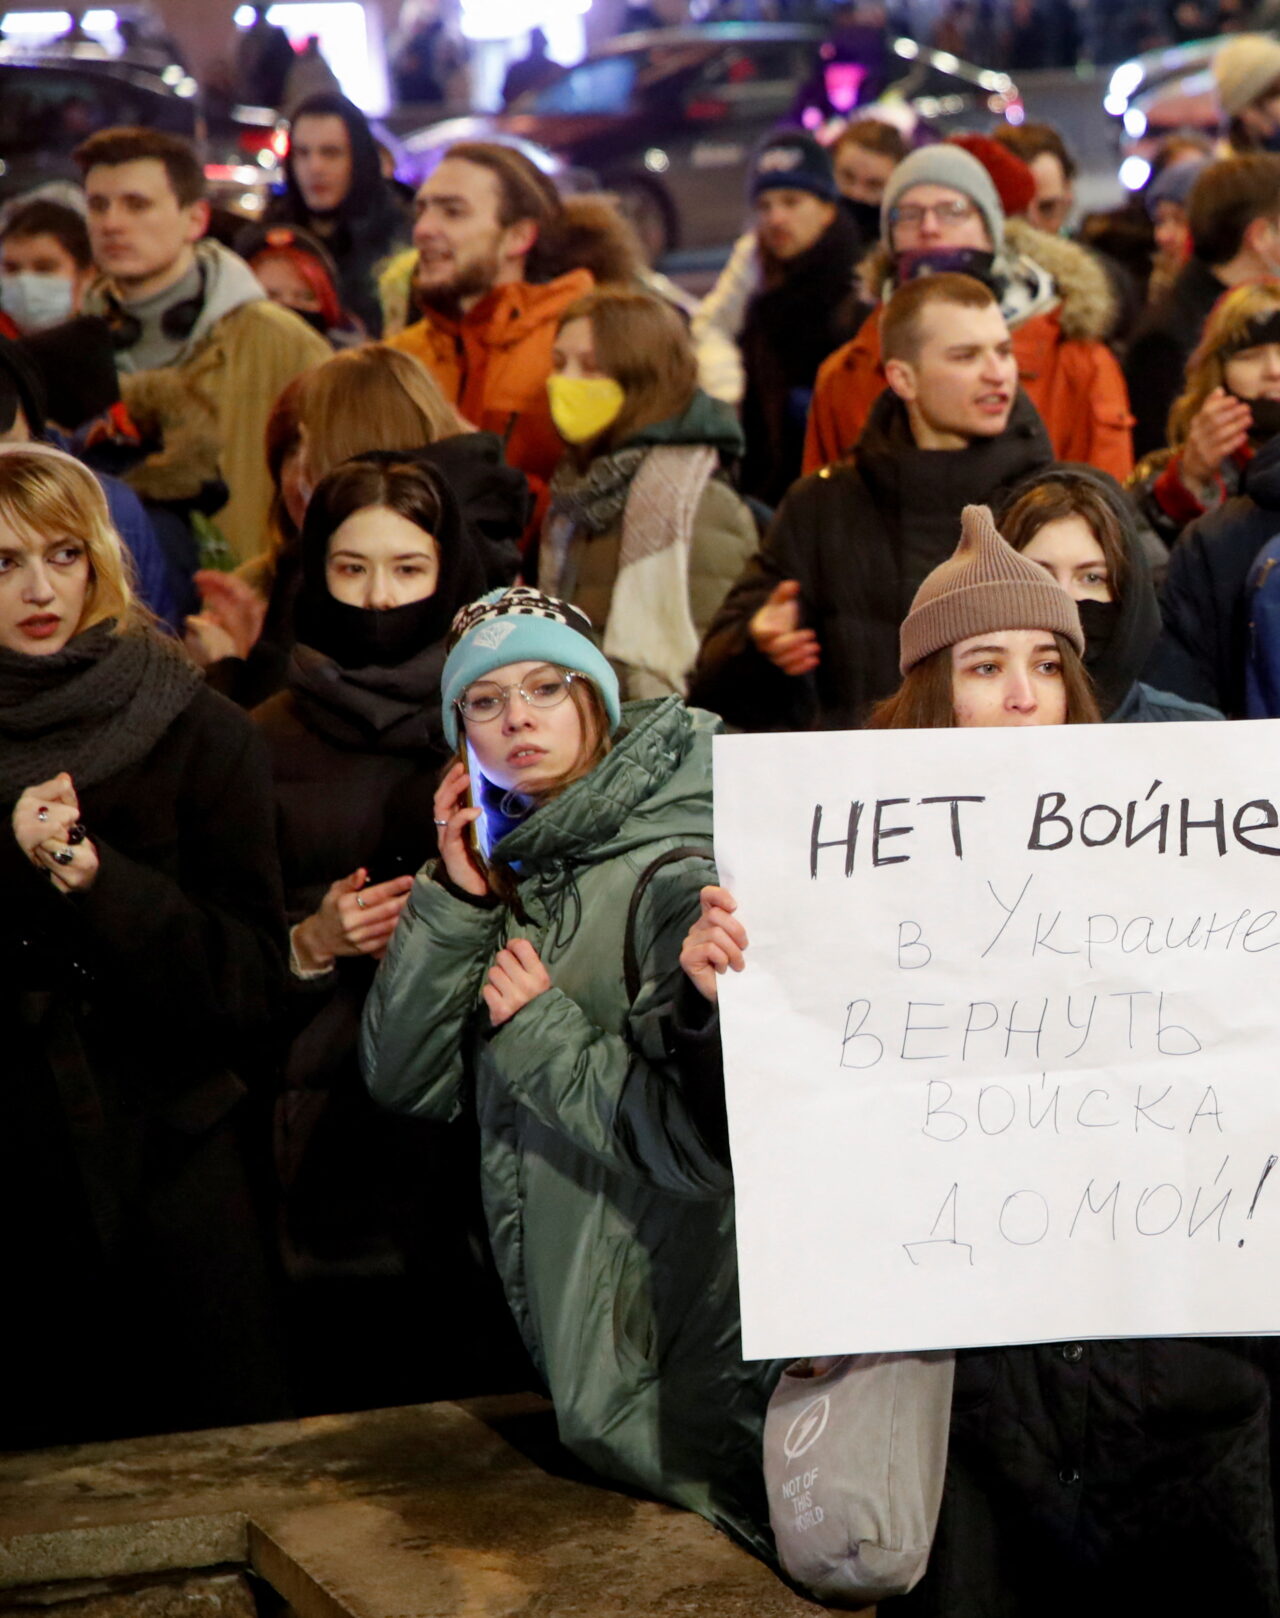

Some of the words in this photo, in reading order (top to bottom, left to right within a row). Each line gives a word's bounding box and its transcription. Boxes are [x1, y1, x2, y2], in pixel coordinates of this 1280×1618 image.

[809, 795, 987, 880] НЕТ
[839, 991, 1203, 1069] ВЕРНУТЬ
[921, 1071, 1224, 1142] ВОЙСКА
[901, 1153, 1279, 1266] ДОМОЙ!
[782, 1475, 801, 1500] NOT
[803, 1467, 819, 1489] OF
[791, 1490, 812, 1515] THIS
